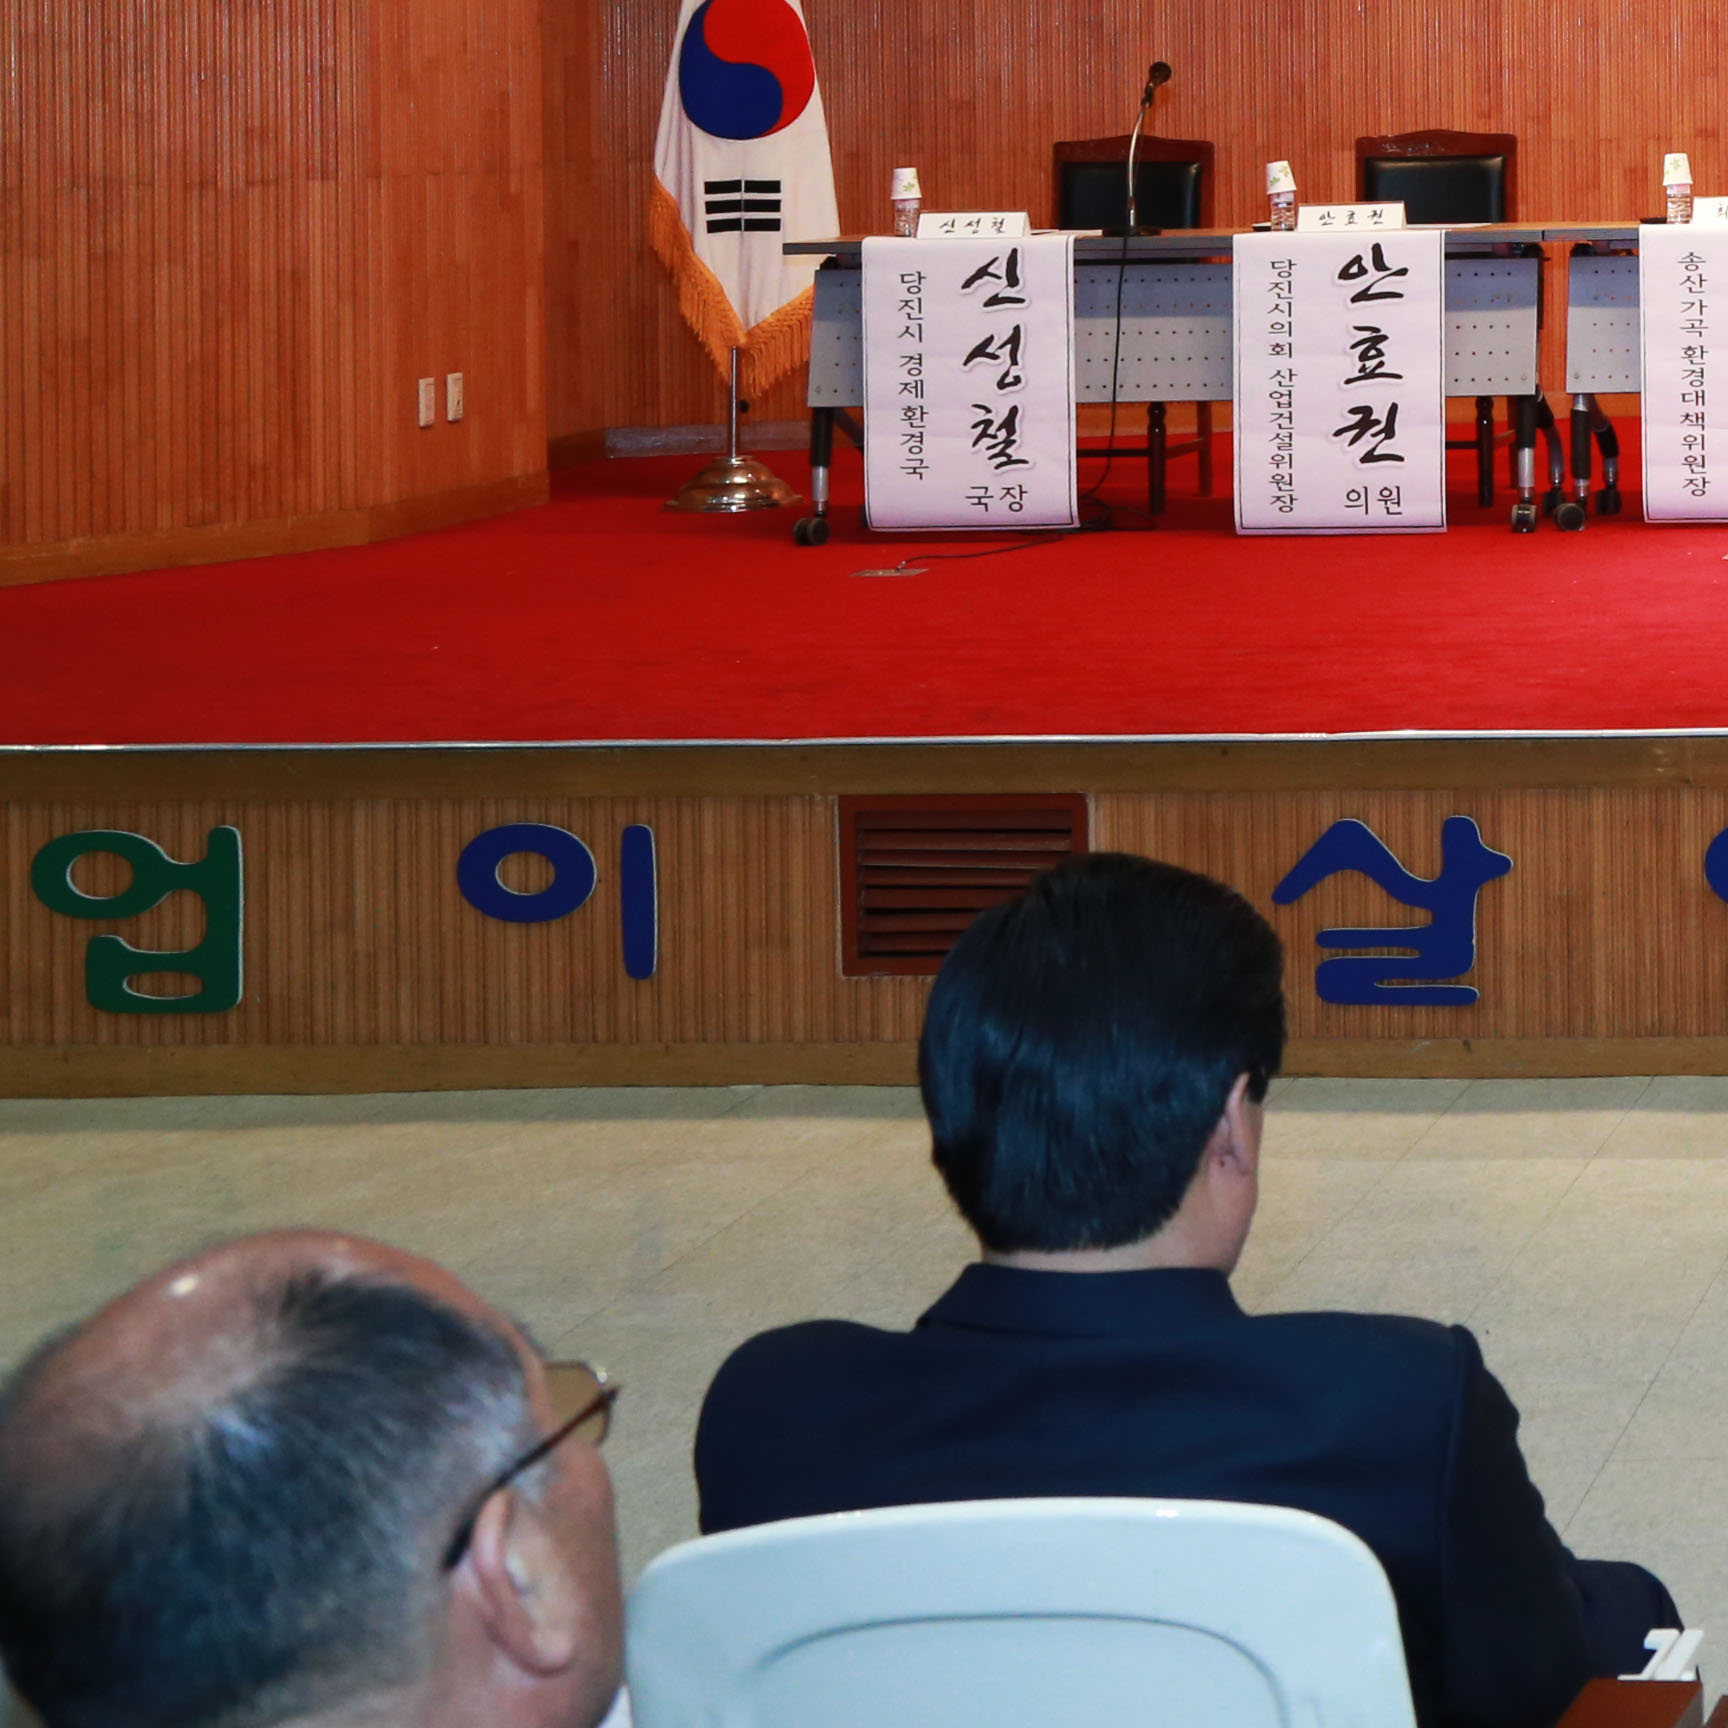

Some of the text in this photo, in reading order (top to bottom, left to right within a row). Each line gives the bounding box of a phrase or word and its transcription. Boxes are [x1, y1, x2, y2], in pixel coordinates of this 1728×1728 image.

[897, 270, 930, 481] 당진시 경제환경국
[960, 247, 1030, 471] 신성철
[1267, 258, 1299, 514] 당진시의회 산업건설위원장
[1331, 242, 1410, 465] 안효권
[1678, 251, 1711, 497] 송산가곡 환경대책위원장
[964, 484, 1029, 513] 국장
[1343, 485, 1403, 516] 의원
